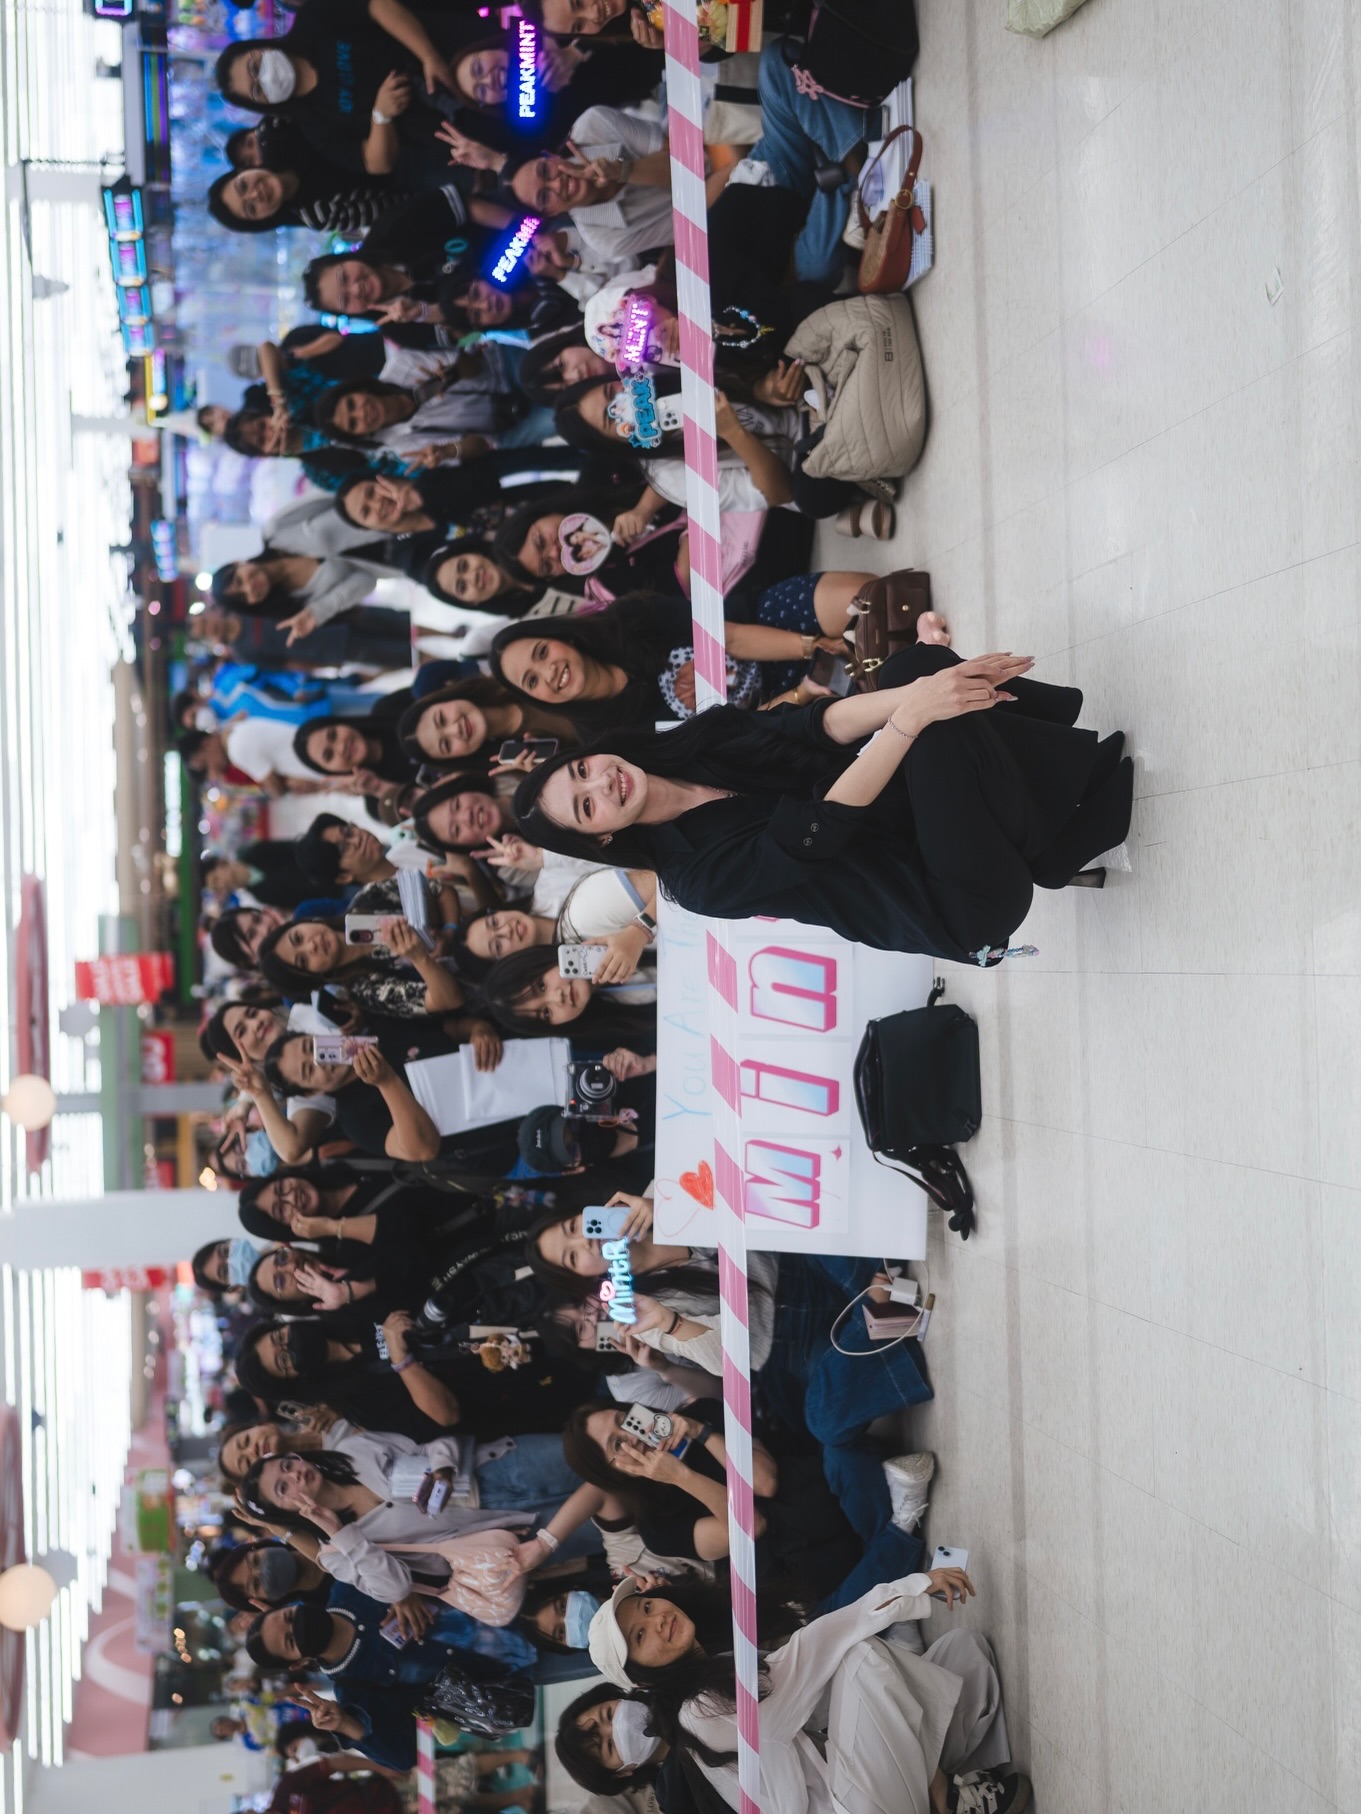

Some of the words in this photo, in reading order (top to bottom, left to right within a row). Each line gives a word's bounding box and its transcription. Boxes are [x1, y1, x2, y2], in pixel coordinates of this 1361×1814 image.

[518, 20, 536, 118] PEAKMINT
[623, 303, 649, 363] MINT
[630, 377, 658, 439] PEAK
[661, 974, 705, 1037] Are
[661, 1051, 713, 1121] You
[739, 915, 840, 1230] Min
[600, 1237, 638, 1324] MintR
